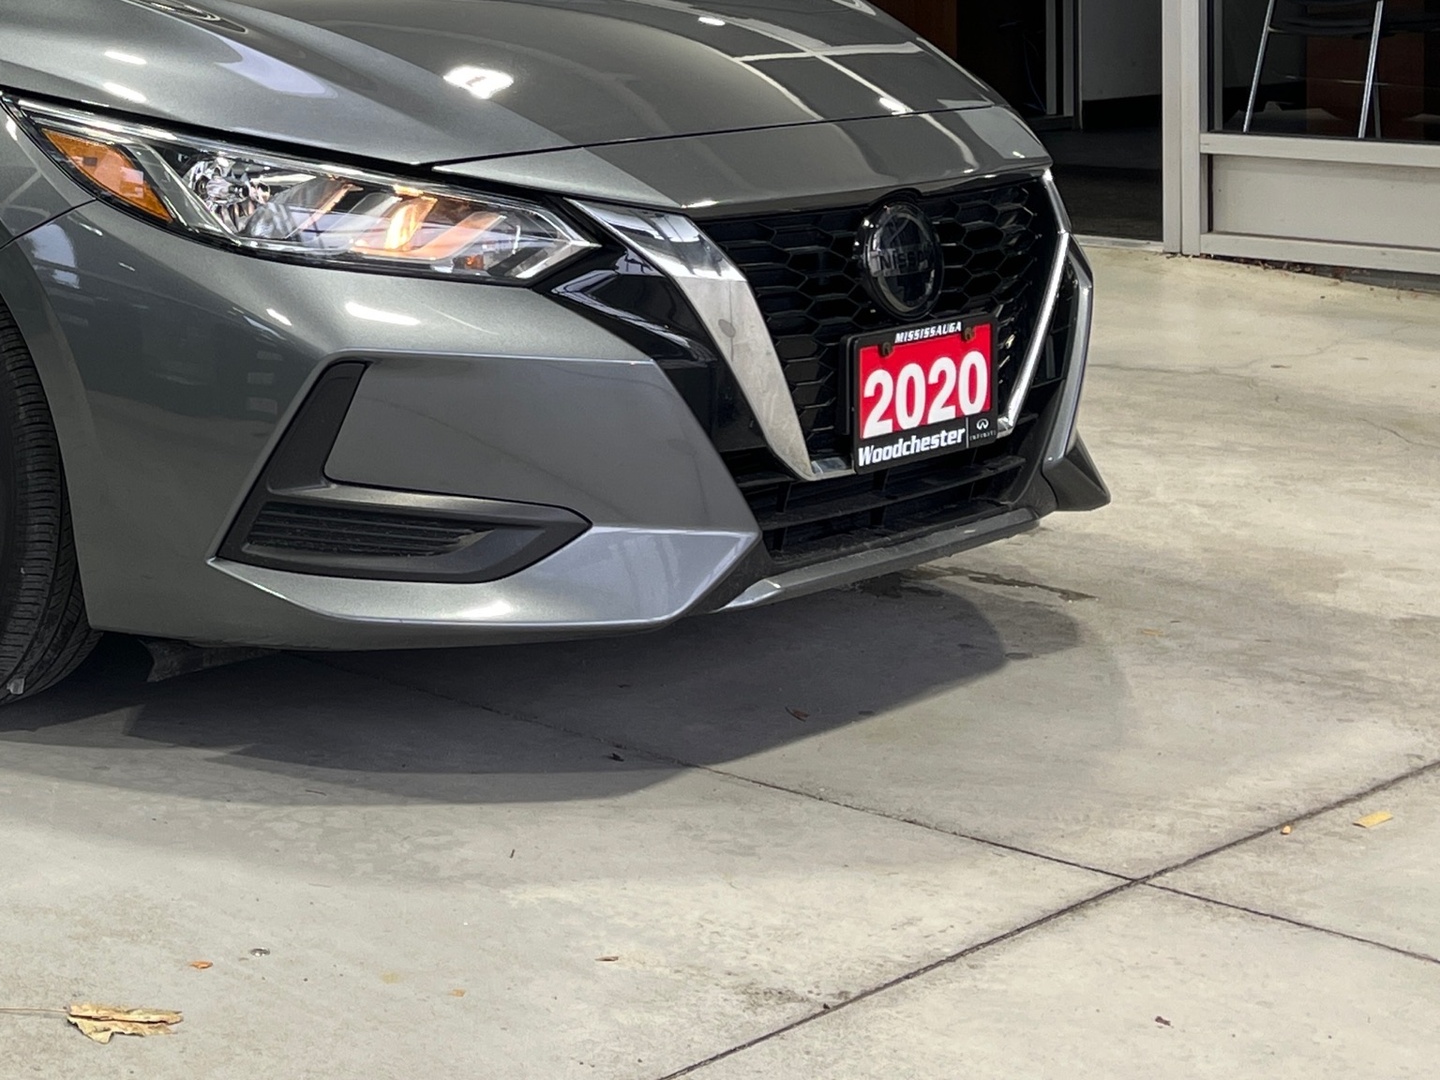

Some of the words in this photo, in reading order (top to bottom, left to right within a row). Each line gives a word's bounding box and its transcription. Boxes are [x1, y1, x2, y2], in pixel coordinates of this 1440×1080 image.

[879, 248, 930, 270] NISSA
[894, 321, 962, 344] MISSISSAUGA
[862, 350, 988, 439] 2020
[858, 427, 966, 467] Woodchester
